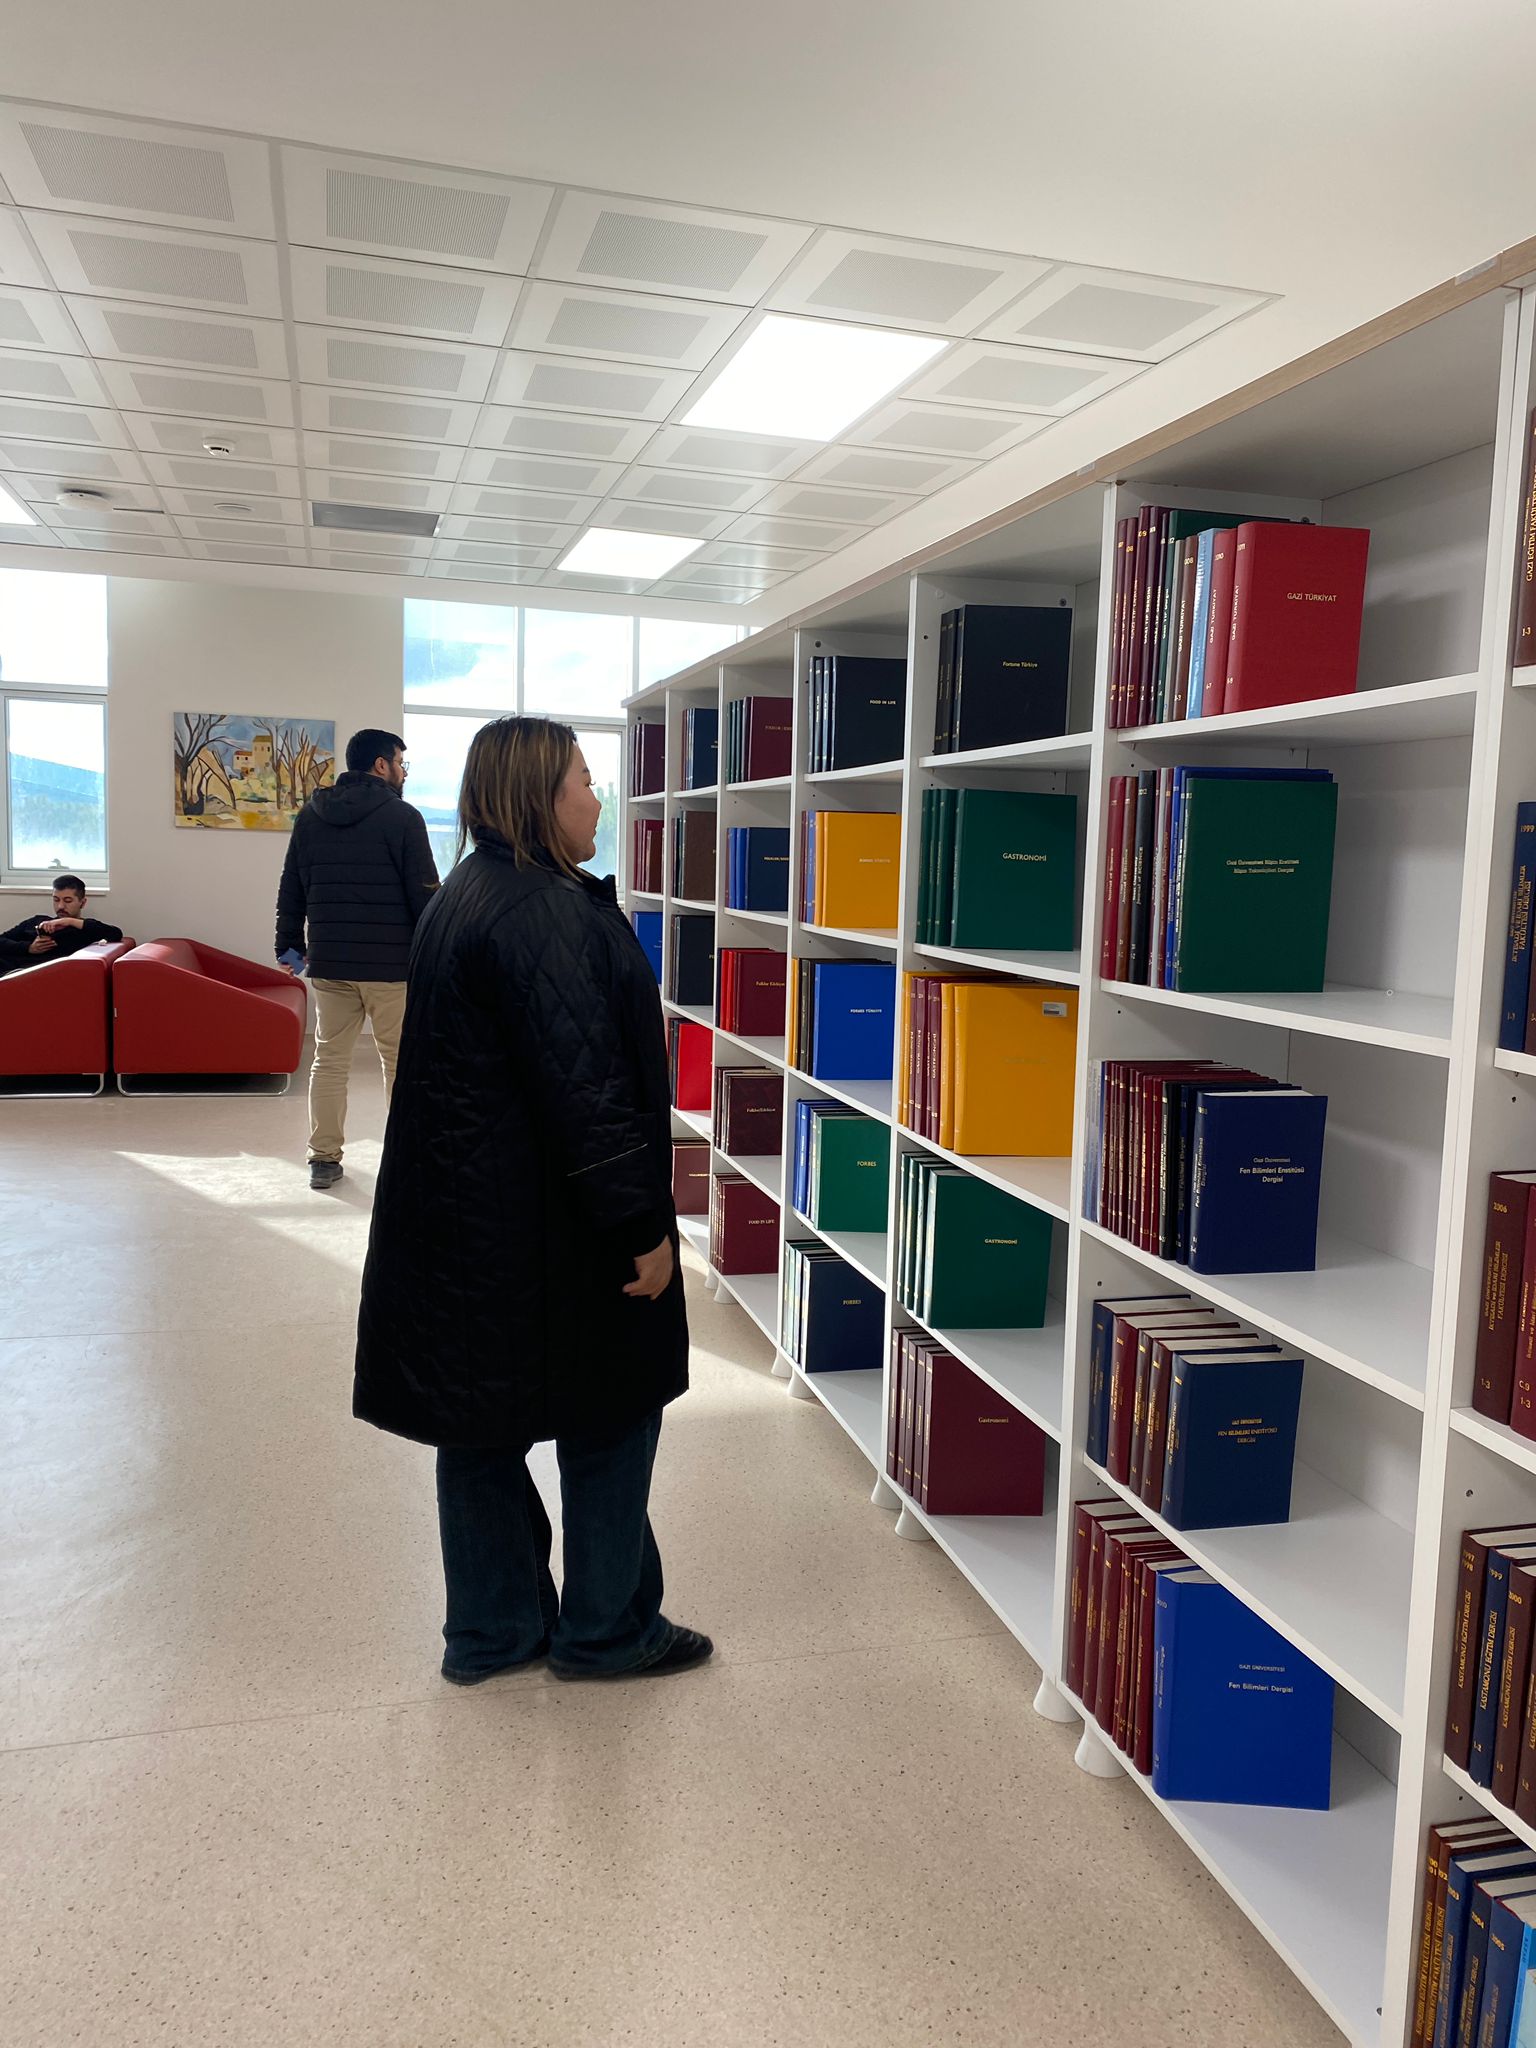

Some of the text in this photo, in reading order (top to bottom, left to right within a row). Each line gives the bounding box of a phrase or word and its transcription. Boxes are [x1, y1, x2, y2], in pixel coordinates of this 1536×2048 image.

[1286, 592, 1336, 602] GAZİ TÜRKİYAT
[1002, 852, 1047, 862] GASTRONOMİ
[1262, 1176, 1284, 1184] Dergisi
[1270, 1685, 1294, 1693] Dergisi
[1480, 1663, 1492, 1710] KASTAMONU
